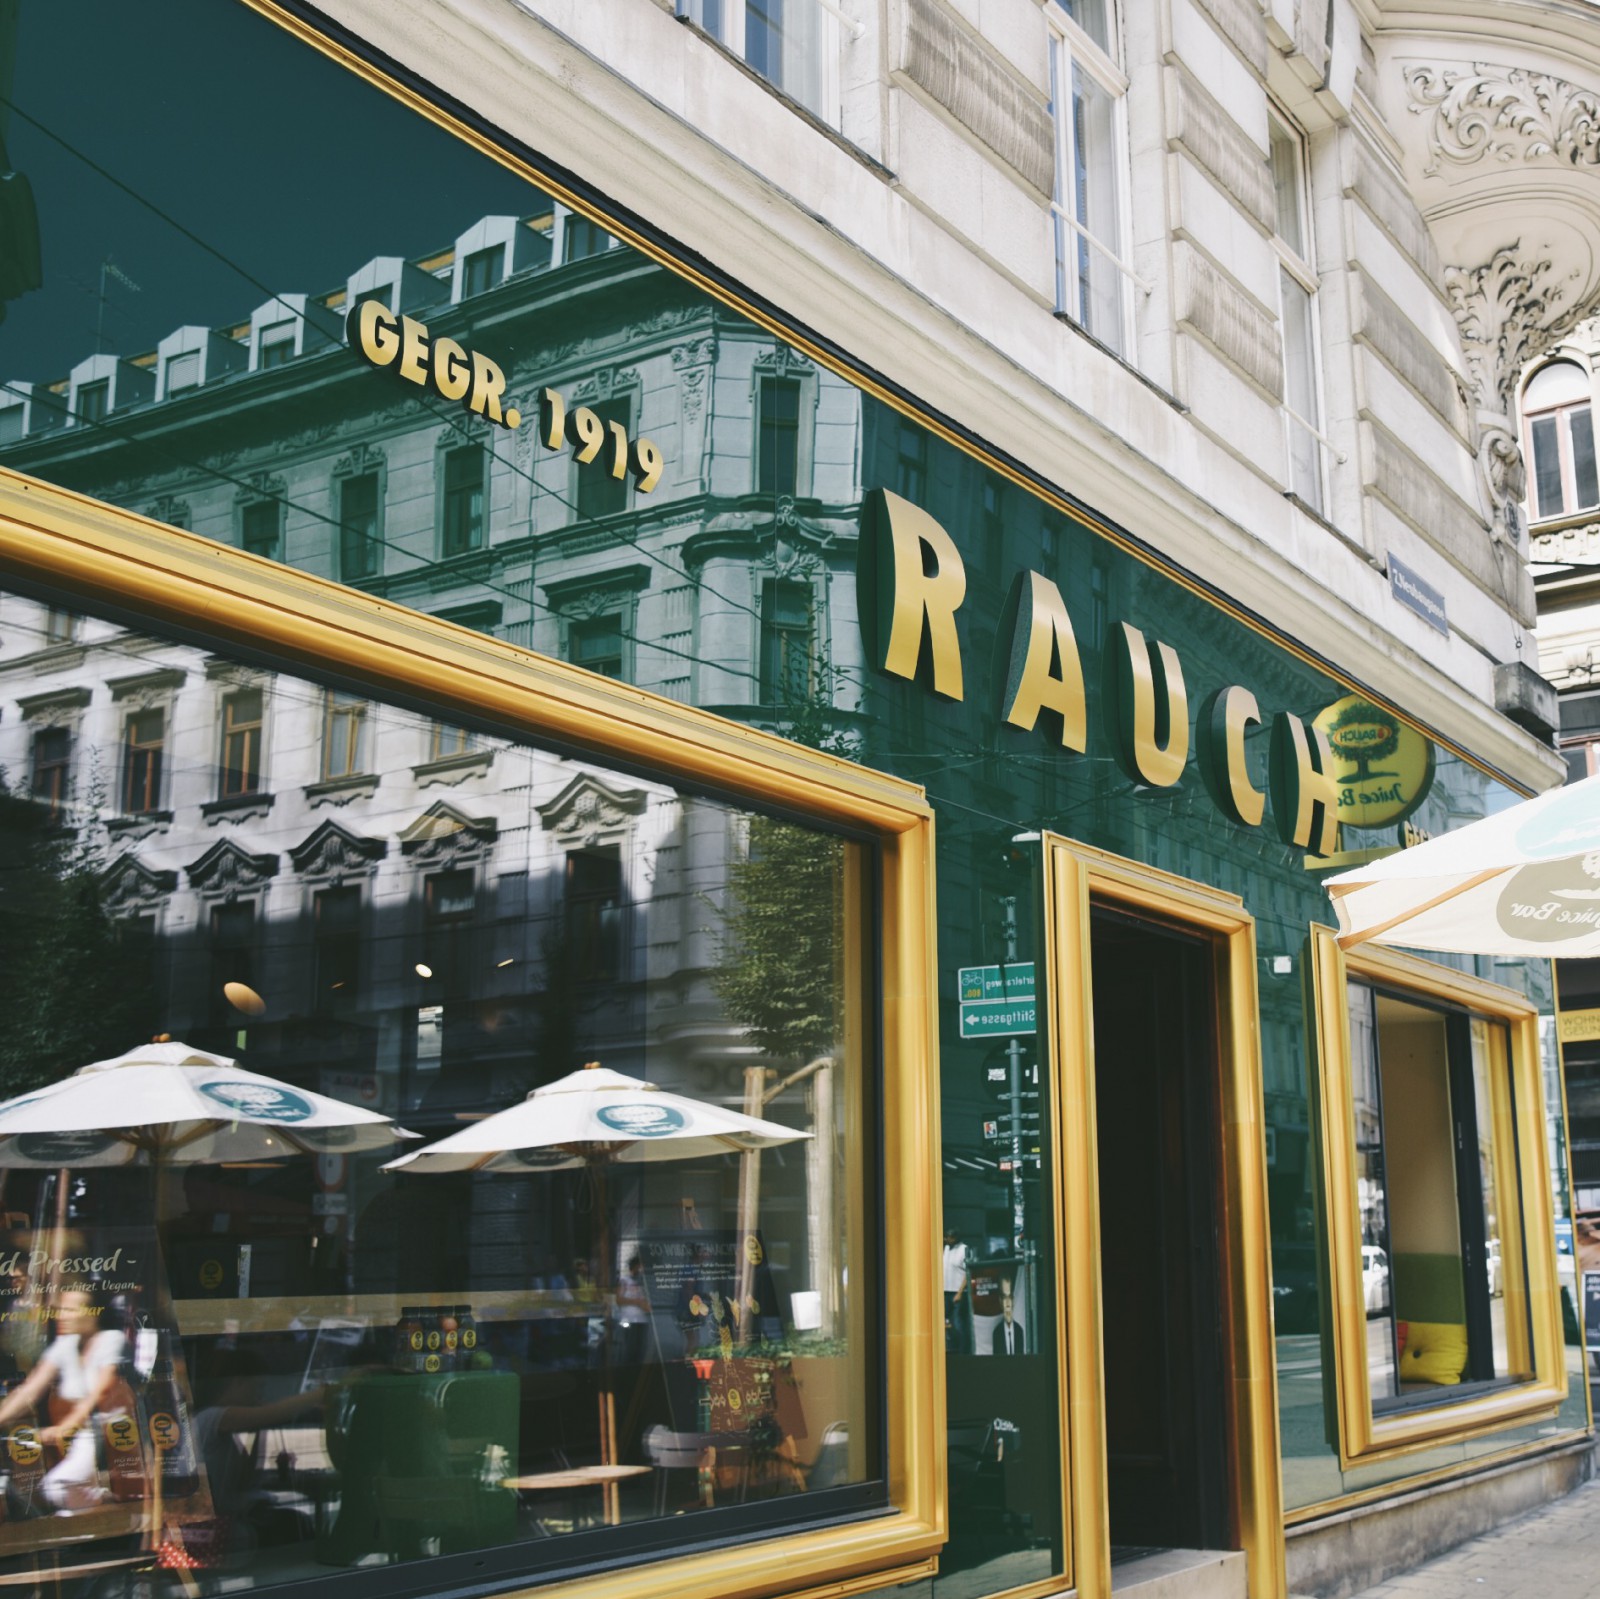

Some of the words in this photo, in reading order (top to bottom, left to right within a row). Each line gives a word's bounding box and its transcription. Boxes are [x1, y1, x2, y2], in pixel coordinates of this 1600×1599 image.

[359, 300, 522, 429] GEGR.
[545, 386, 664, 494] 1919
[880, 487, 1338, 858] RAUCH
[27, 1248, 123, 1276] Pressed
[27, 1281, 59, 1295] Nicht
[101, 1279, 138, 1293] Vegan.
